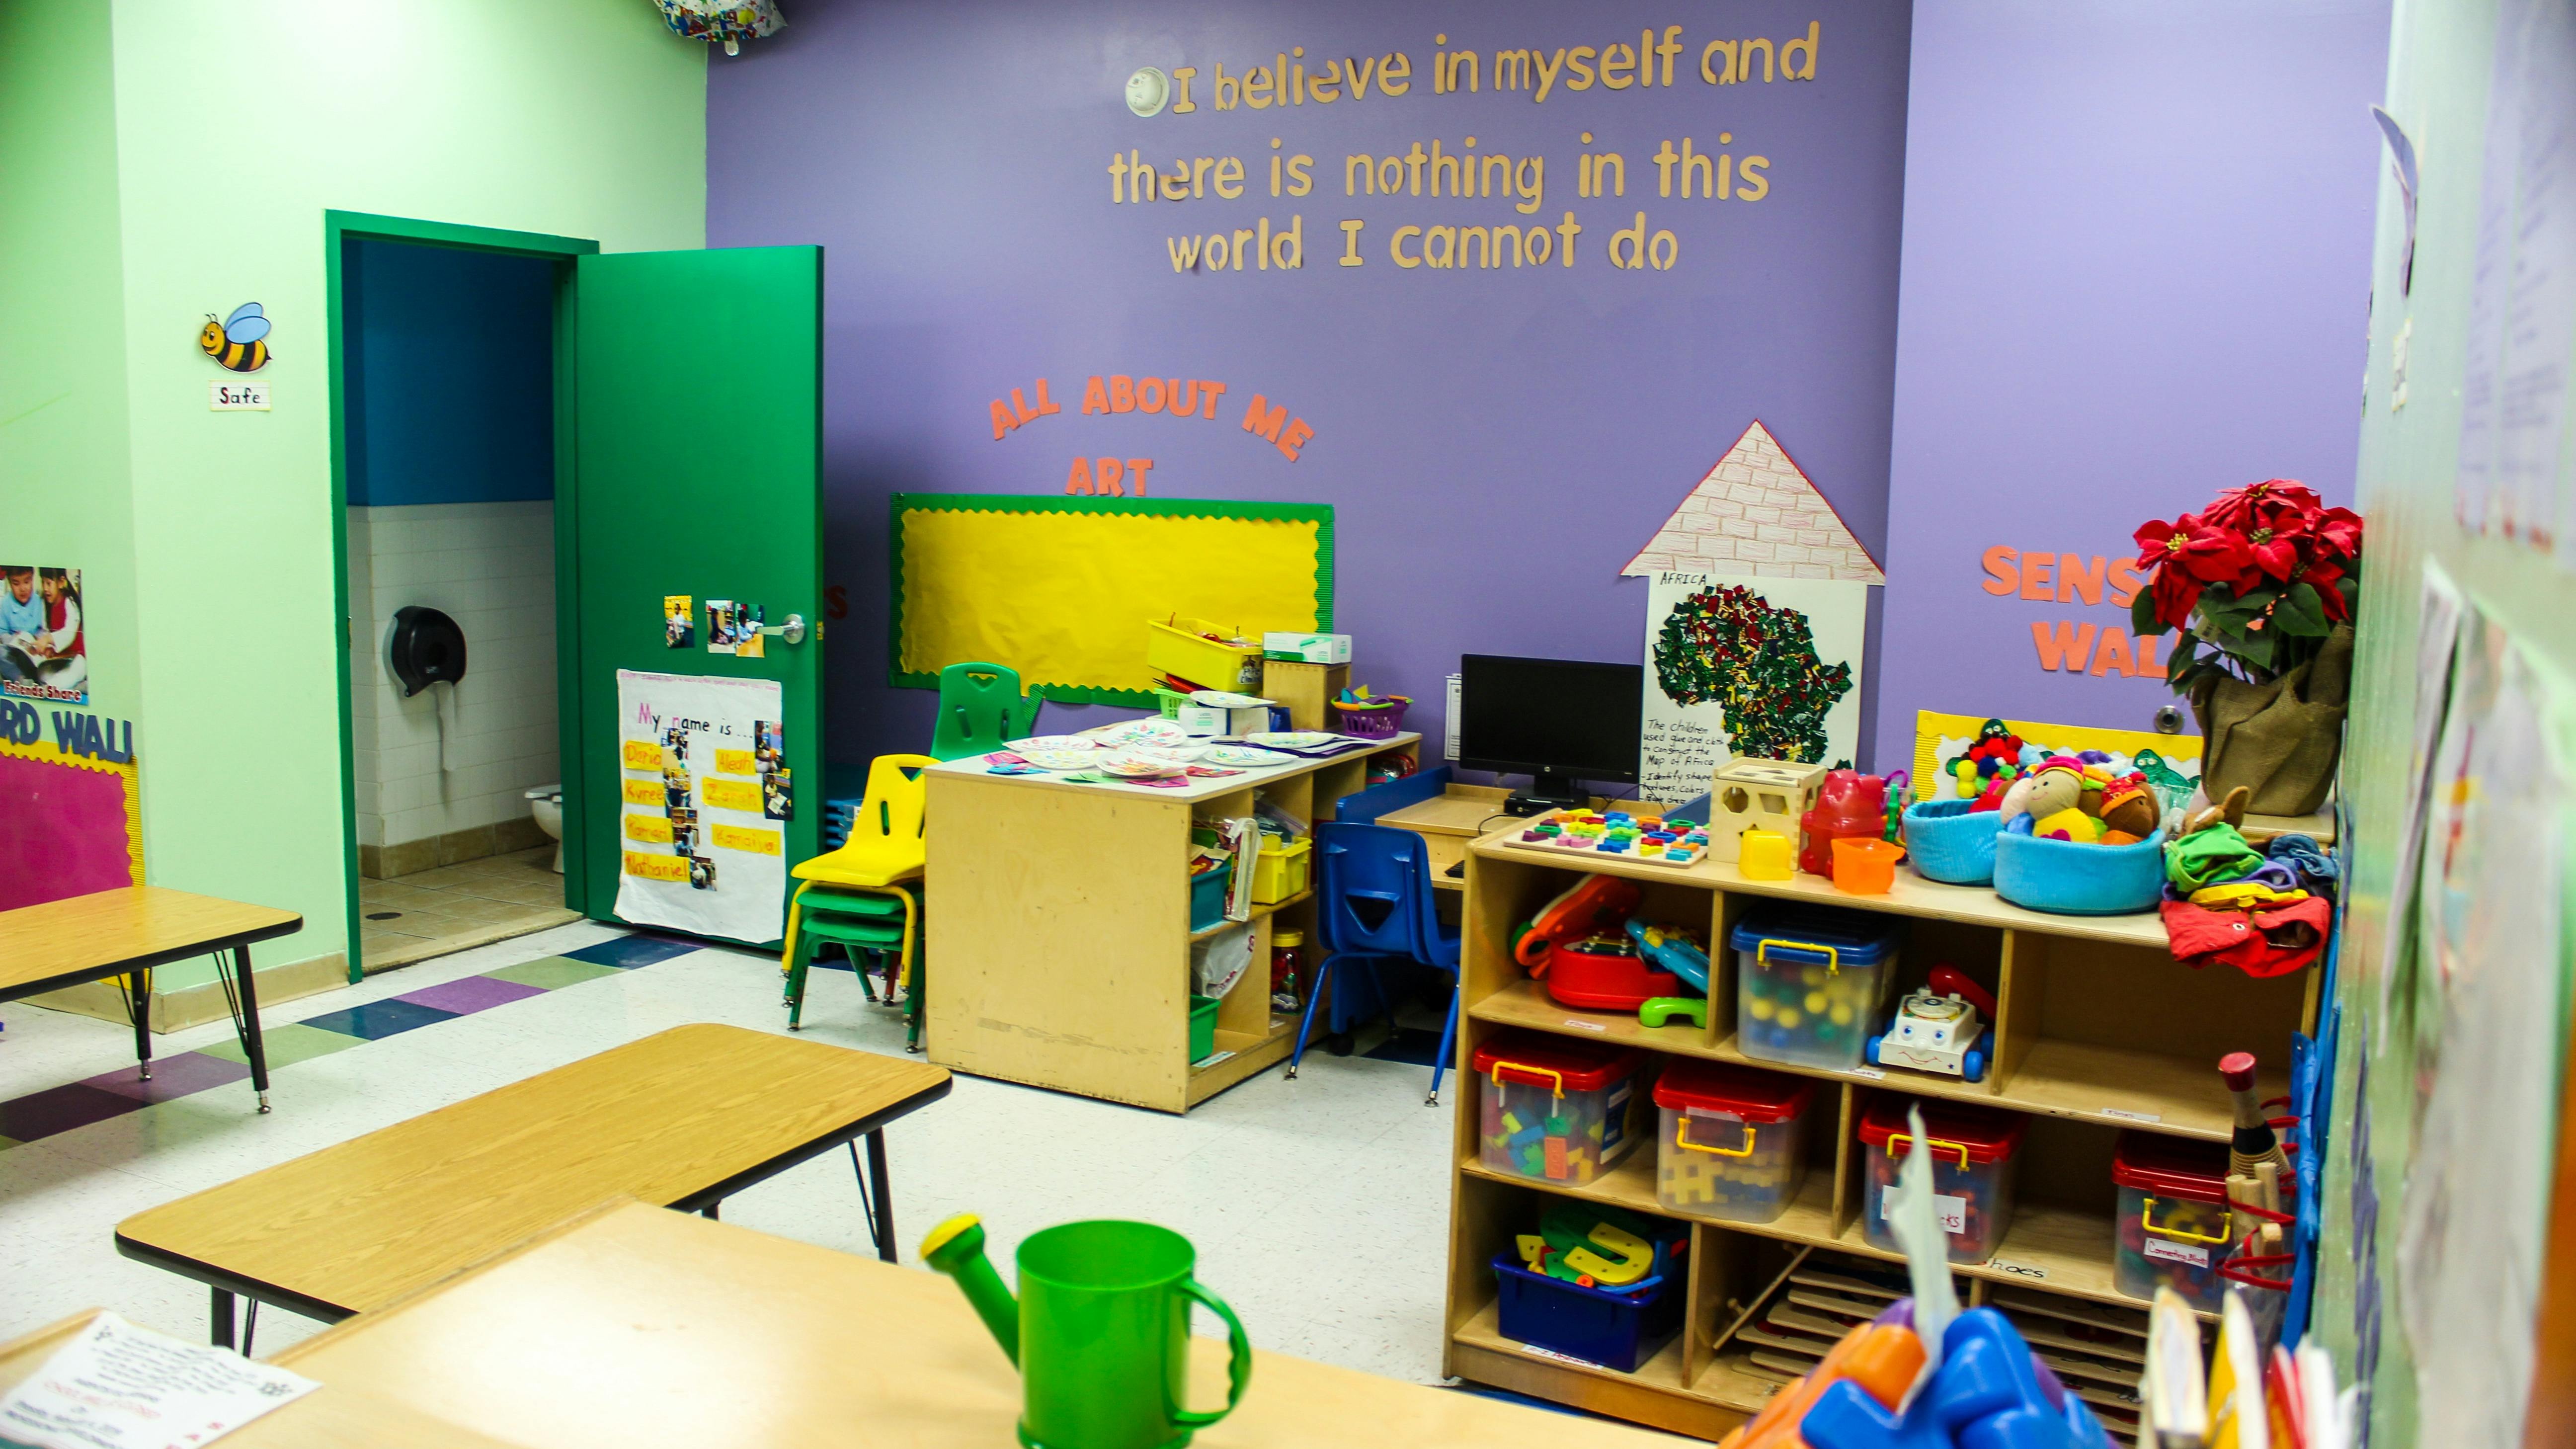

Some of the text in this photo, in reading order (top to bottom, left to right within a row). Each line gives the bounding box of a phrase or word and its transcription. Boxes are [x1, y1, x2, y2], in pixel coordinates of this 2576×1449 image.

[1173, 20, 1820, 114] I believe in myself and
[1108, 132, 1770, 214] there is nothing in this
[1168, 211, 1679, 273] world I cannot do
[219, 387, 260, 404] Safe
[989, 375, 1315, 463] ALL ABOUT ME
[1065, 457, 1153, 497] ART
[1660, 571, 1706, 585] AFRICA
[1982, 545, 2158, 609] SENS
[3, 680, 81, 702] Friends Share
[638, 702, 661, 733] My
[672, 716, 710, 731] name
[720, 718, 731, 735] is
[1647, 719, 1708, 734] The children
[1643, 732, 1666, 741] used
[1646, 755, 1665, 769] Map
[1671, 754, 1682, 766] of
[1694, 745, 1710, 755] the
[625, 854, 689, 878] Nathaniel
[1984, 1258, 2044, 1278] hoes
